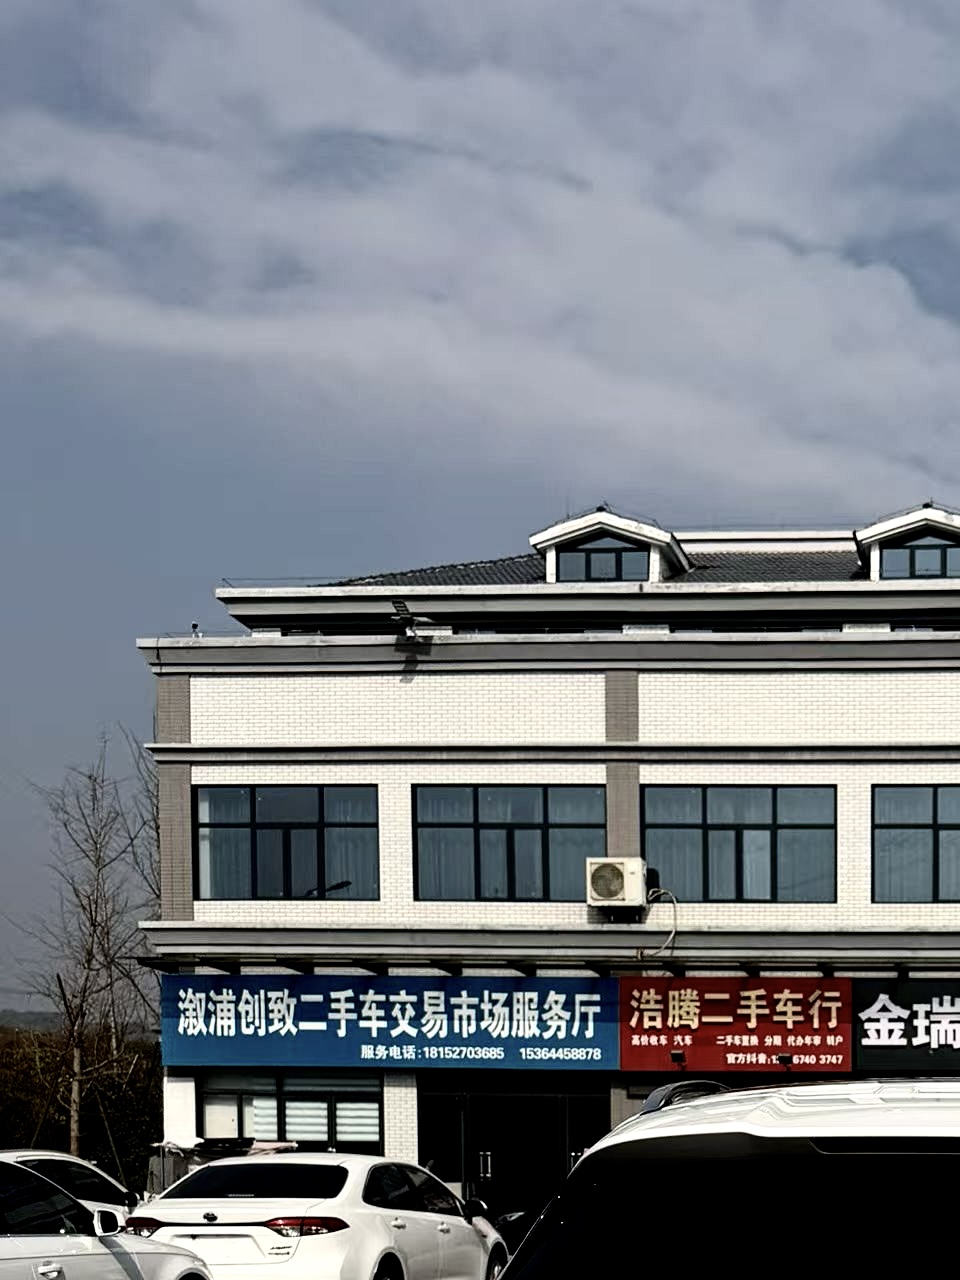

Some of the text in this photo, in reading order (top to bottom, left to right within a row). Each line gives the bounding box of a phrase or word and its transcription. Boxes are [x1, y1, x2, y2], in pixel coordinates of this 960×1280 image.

[177, 987, 602, 1040] 溆浦创致二手车交易市场服务厅
[629, 988, 842, 1030] 浩腾二手车行
[631, 1034, 669, 1047] 高价收车
[673, 1034, 694, 1047] 汽车
[519, 1047, 602, 1061] 15364458878
[792, 1054, 817, 1065] 6740
[818, 1054, 844, 1065] 3747
